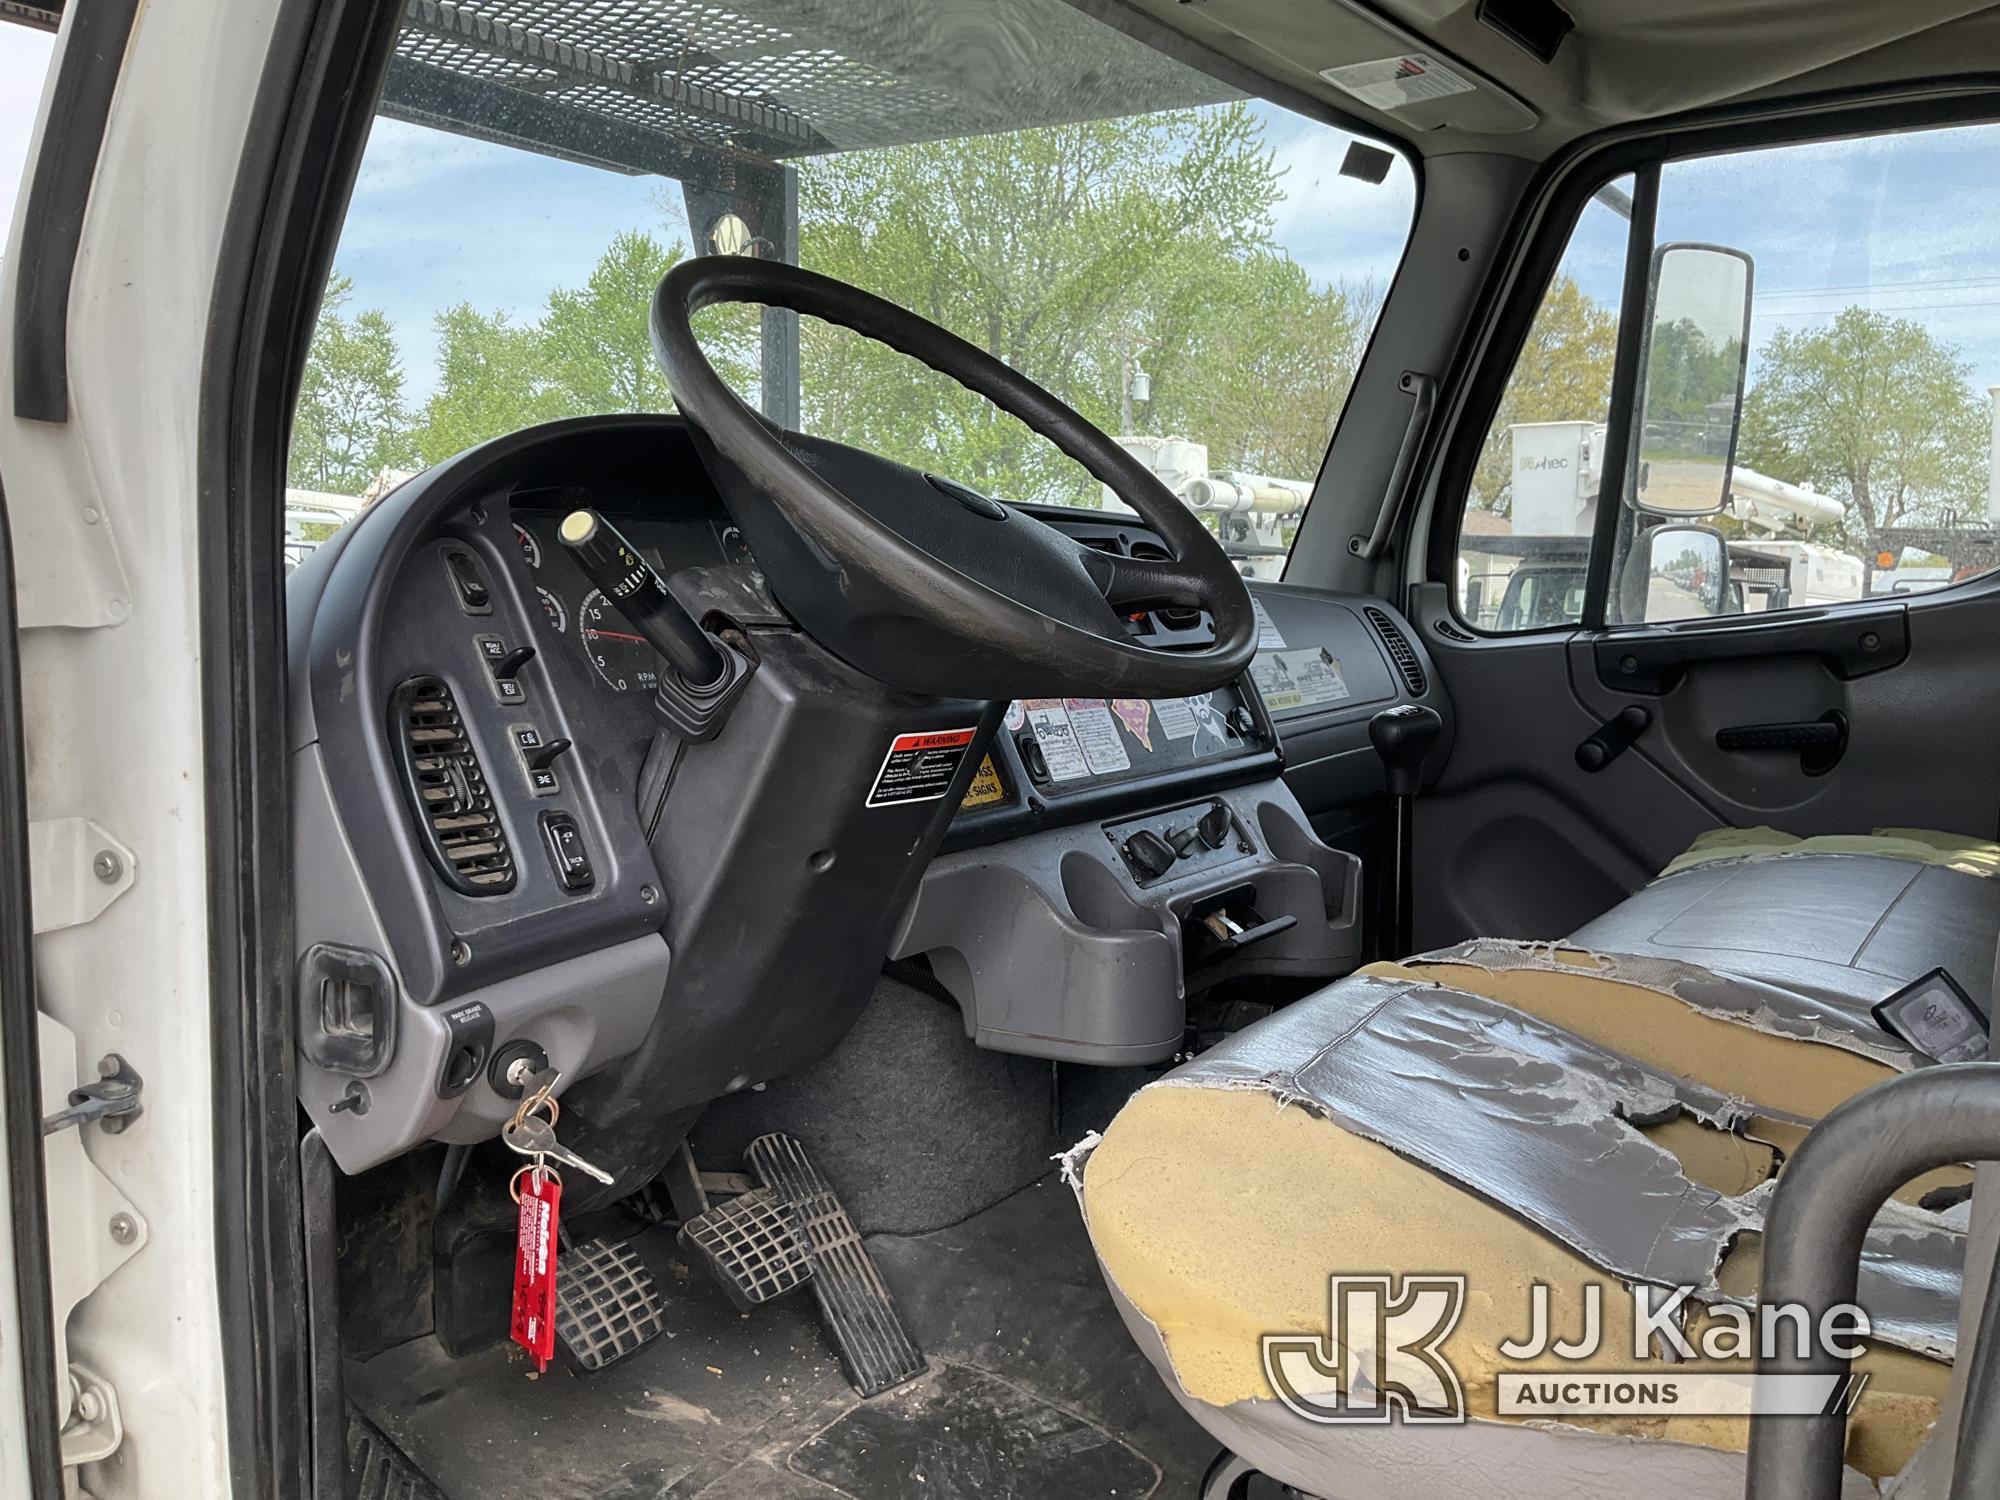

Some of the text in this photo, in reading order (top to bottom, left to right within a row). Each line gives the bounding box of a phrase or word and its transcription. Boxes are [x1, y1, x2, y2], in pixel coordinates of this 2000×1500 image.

[588, 608, 602, 620] 15
[597, 655, 606, 667] 5
[637, 672, 657, 682] RPM
[618, 679, 627, 690] 0
[922, 735, 961, 746] WARNING
[973, 782, 997, 796] SIGNS
